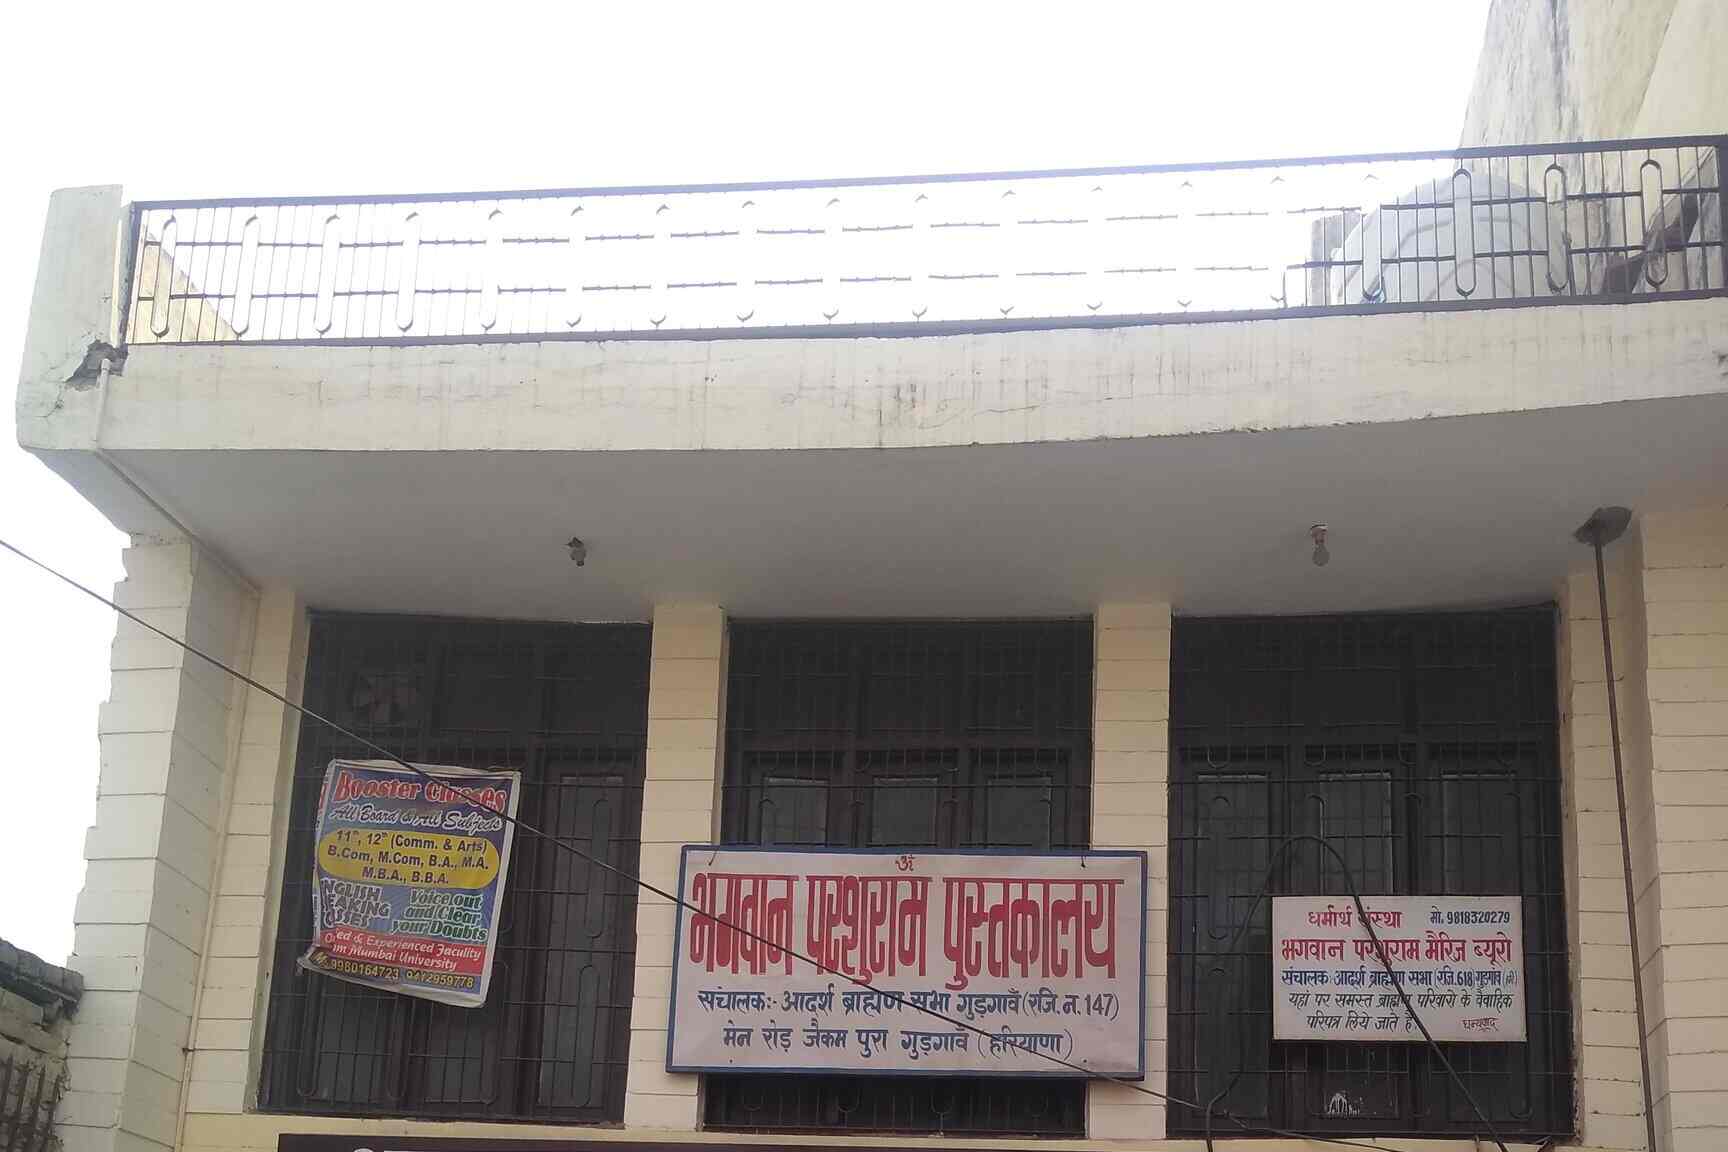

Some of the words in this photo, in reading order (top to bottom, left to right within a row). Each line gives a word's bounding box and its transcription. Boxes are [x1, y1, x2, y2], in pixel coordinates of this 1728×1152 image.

[334, 771, 421, 803] Booster
[390, 829, 438, 851] (Comm.
[457, 839, 488, 854] Arts)
[430, 921, 488, 942] Doubts
[690, 873, 799, 977] भगवान
[805, 875, 933, 986] परशुराम
[942, 876, 1125, 991] पुस्तकालय
[1281, 938, 1346, 963] भगवान
[781, 983, 835, 1016] आदर्श
[724, 1020, 753, 1048] मेन
[855, 1027, 888, 1058] पुरा
